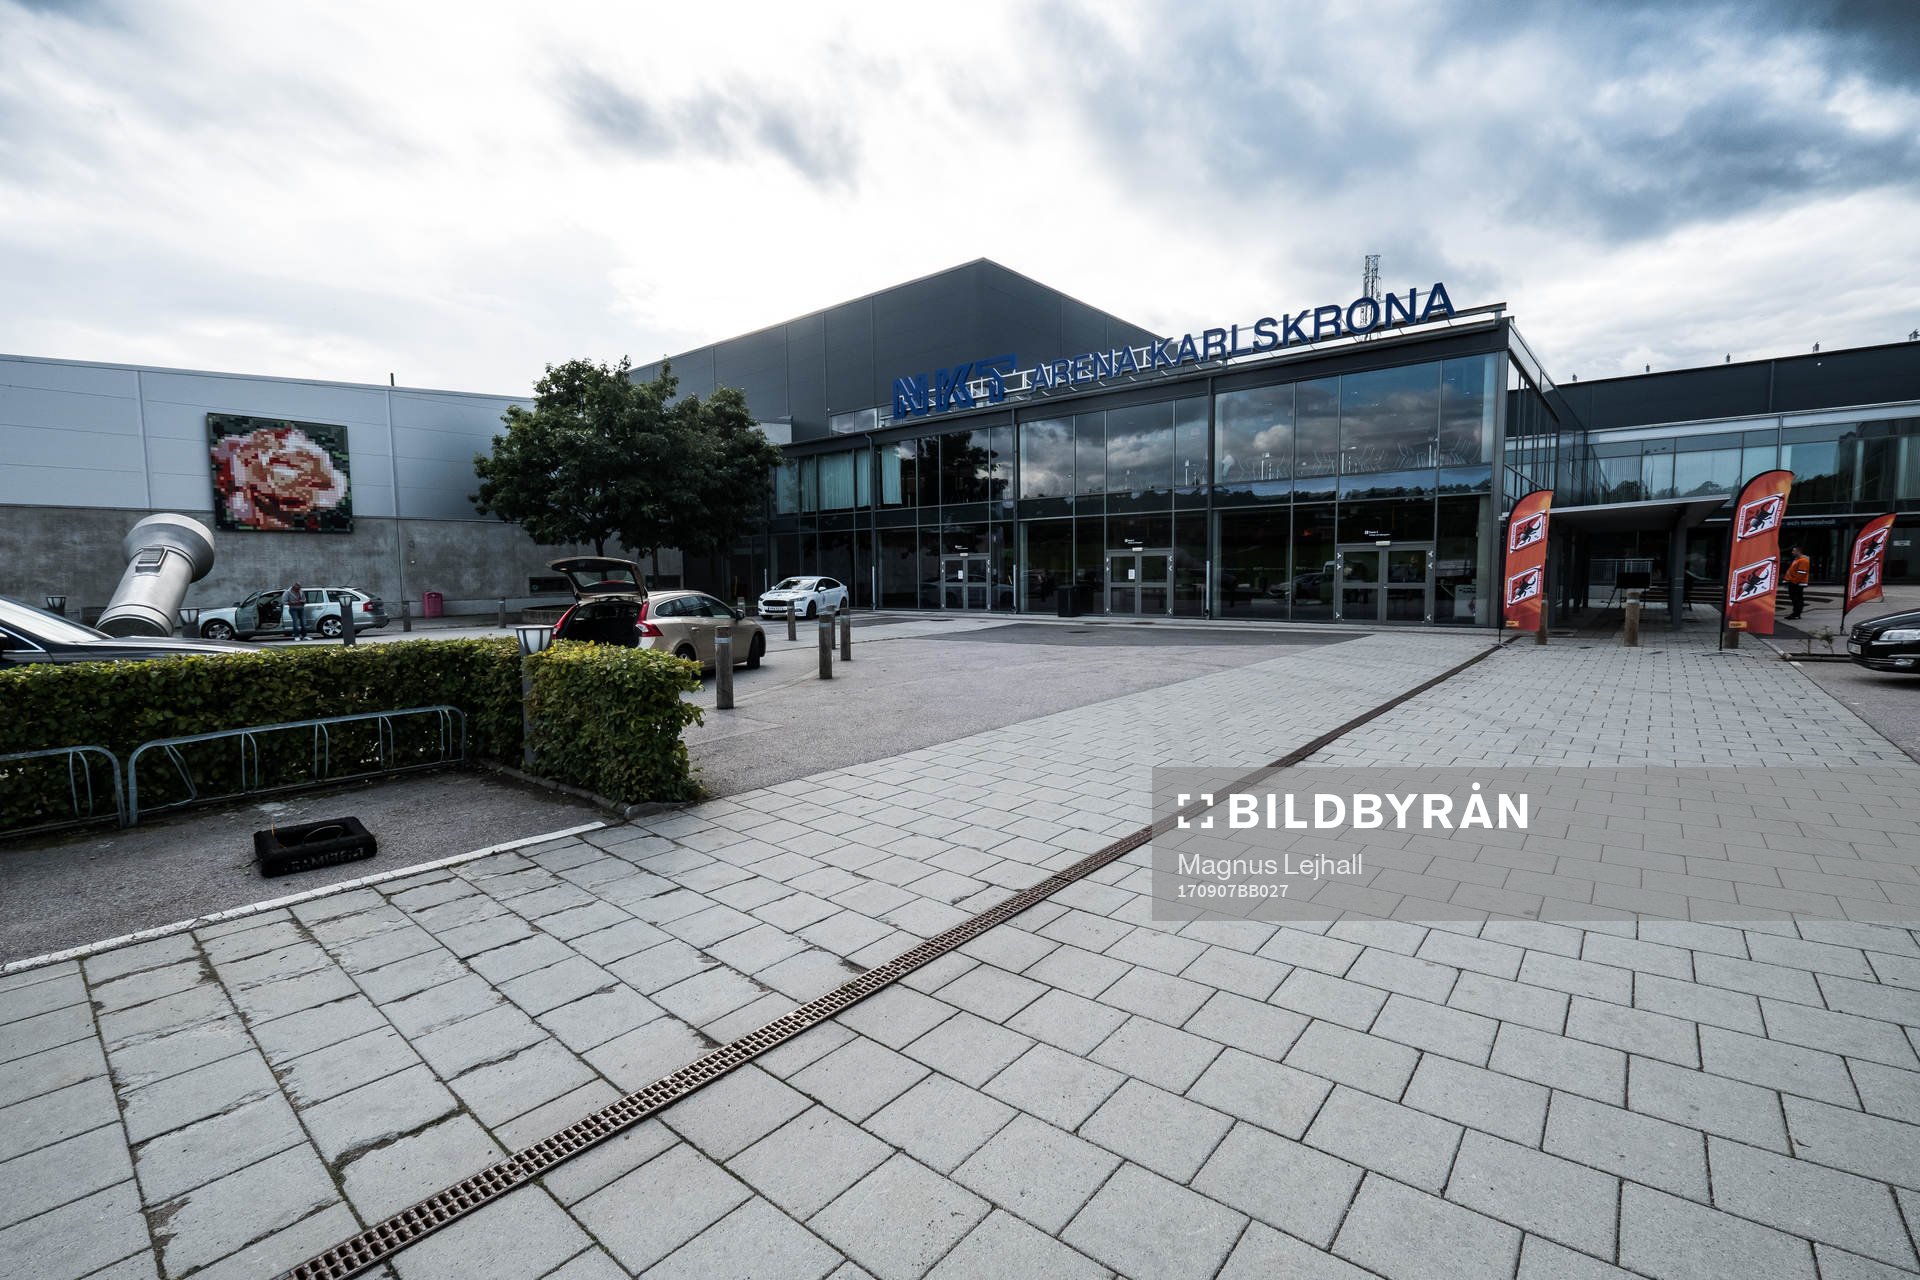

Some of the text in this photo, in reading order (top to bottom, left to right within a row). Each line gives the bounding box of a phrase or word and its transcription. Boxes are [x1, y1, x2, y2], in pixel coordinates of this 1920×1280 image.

[893, 281, 1456, 420] NKT ARENA KARLSKRONA
